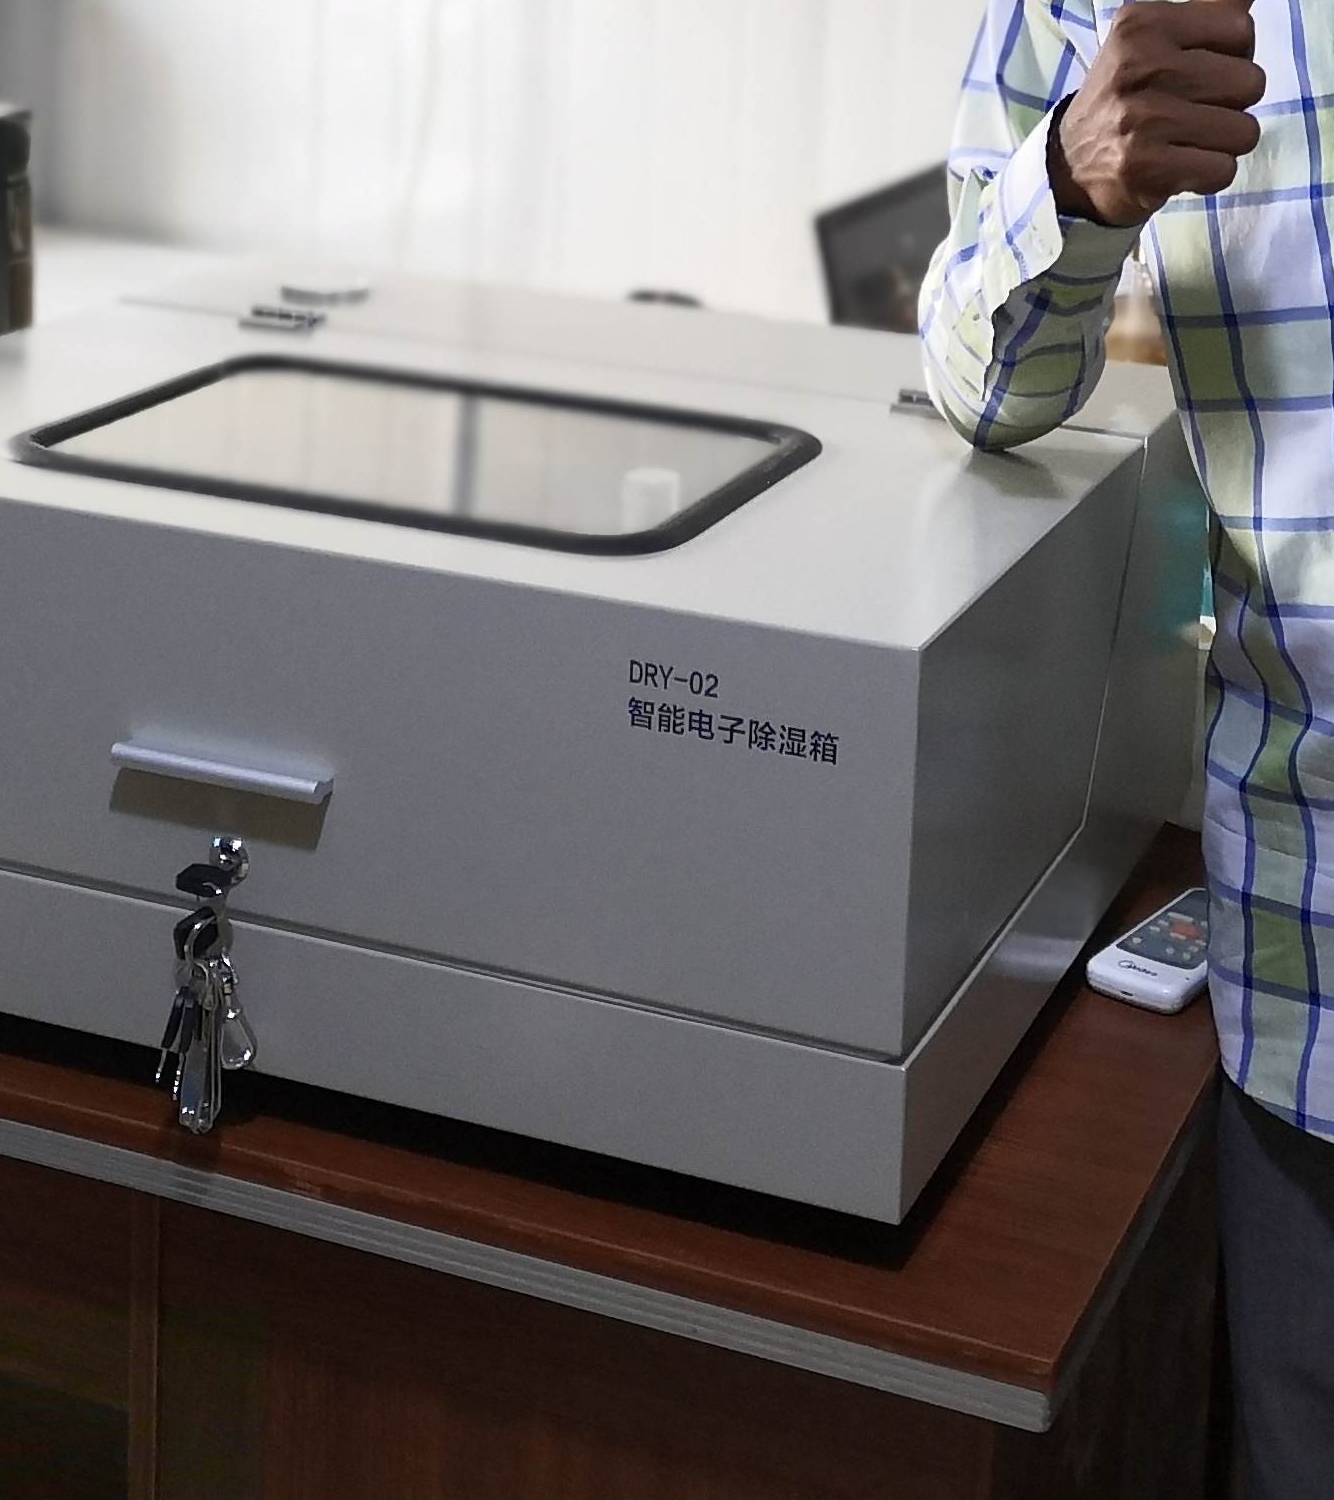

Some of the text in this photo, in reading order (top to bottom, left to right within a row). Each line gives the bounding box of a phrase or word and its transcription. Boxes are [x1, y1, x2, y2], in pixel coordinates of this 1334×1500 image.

[629, 659, 719, 699] DRY-02
[628, 696, 839, 766] 智能电子除湿箱
